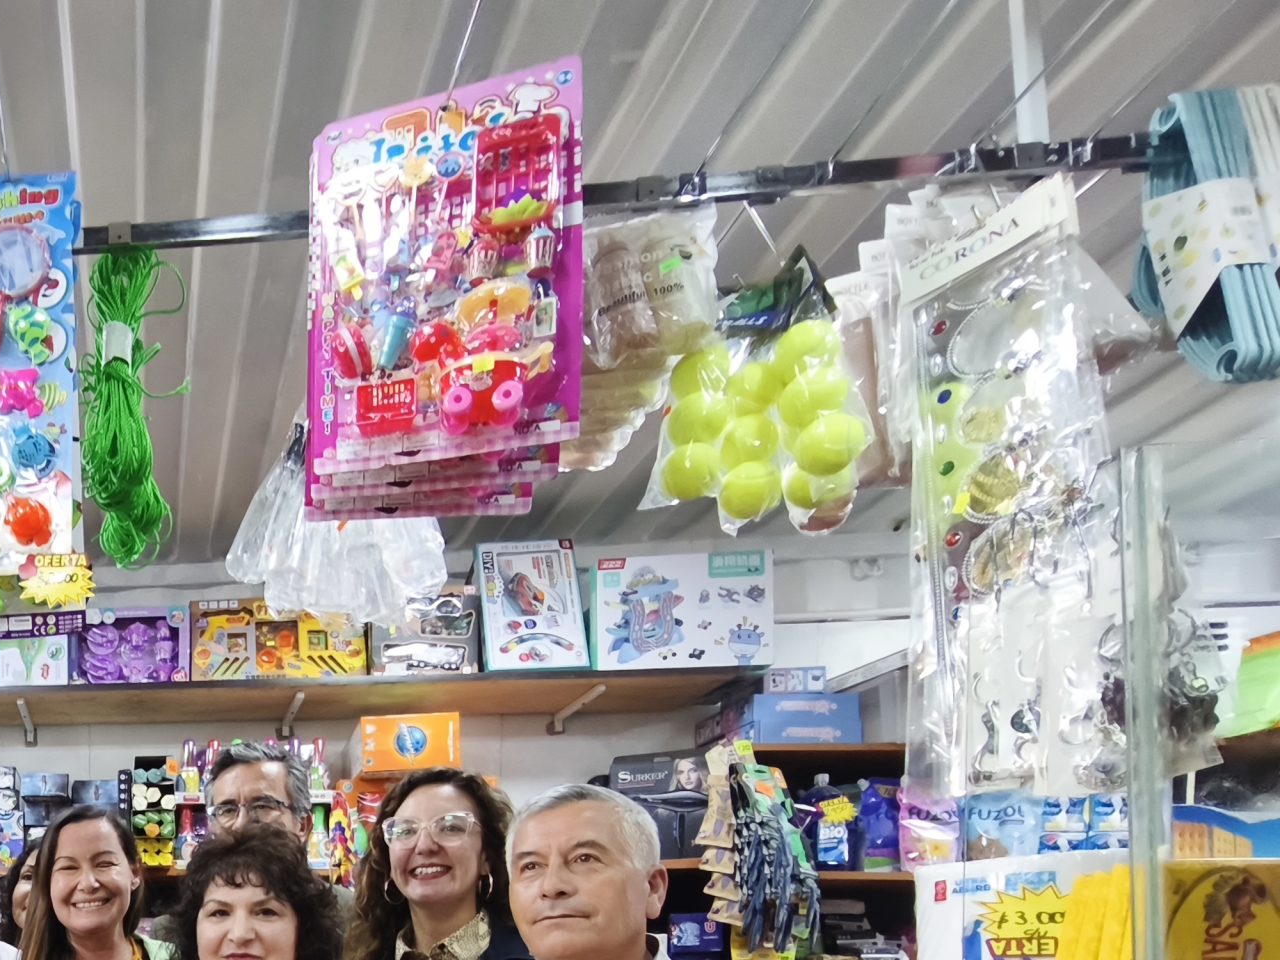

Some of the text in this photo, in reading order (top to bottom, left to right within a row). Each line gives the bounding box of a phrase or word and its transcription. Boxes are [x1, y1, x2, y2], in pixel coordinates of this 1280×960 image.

[919, 217, 1020, 281] CORONA
[652, 281, 685, 297] 100%
[34, 554, 88, 568] OFERTA
[617, 770, 667, 784] SURKER
[988, 937, 1059, 957] ERTA
